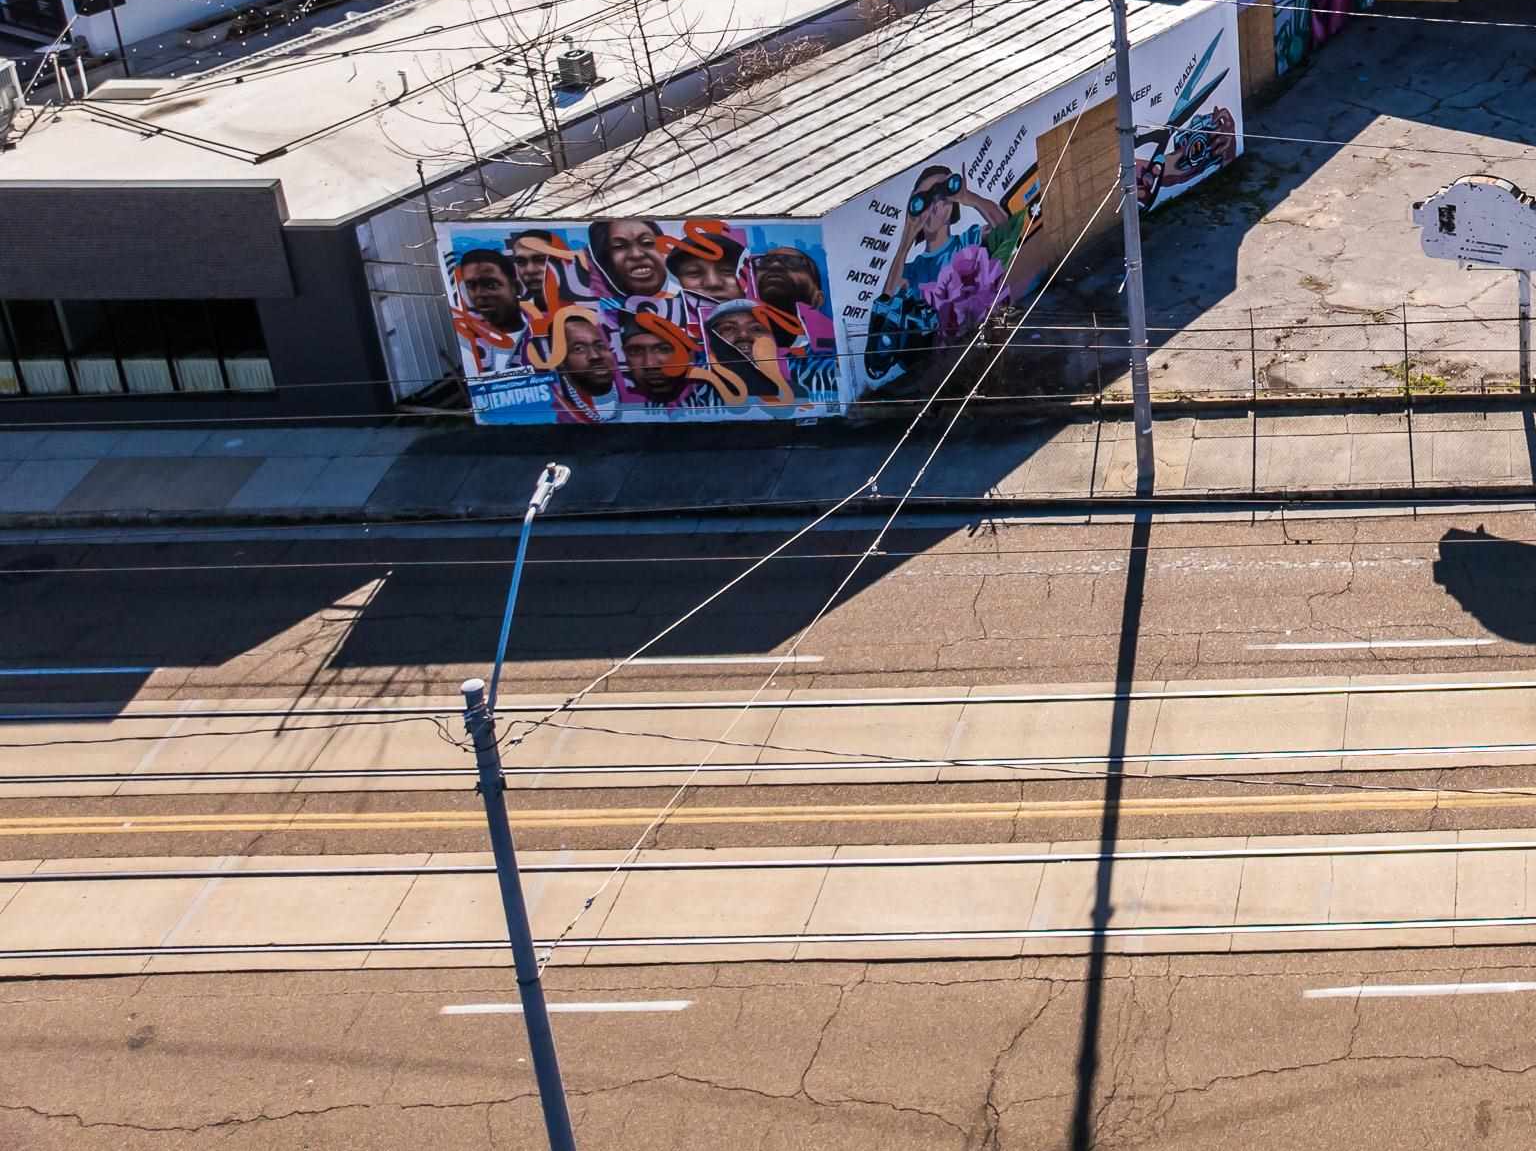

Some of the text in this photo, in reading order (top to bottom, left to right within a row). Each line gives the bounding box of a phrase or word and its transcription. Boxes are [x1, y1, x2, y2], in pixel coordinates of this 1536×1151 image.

[1173, 53, 1198, 96] DEADLY
[1130, 84, 1152, 102] KEEP
[1150, 92, 1162, 108] ME
[1052, 98, 1078, 125] MAKE
[1085, 83, 1098, 99] ME
[967, 135, 992, 179] PRUNE
[986, 124, 1027, 192] PROPAGATE
[977, 159, 994, 188] AND
[1001, 169, 1015, 191] ME
[868, 199, 901, 220] PLUCK
[879, 222, 897, 236] ME
[859, 236, 890, 252] FROM
[869, 256, 888, 271] MY
[846, 270, 880, 286] PATCH
[857, 290, 873, 302] OF
[842, 305, 869, 319] DIRT
